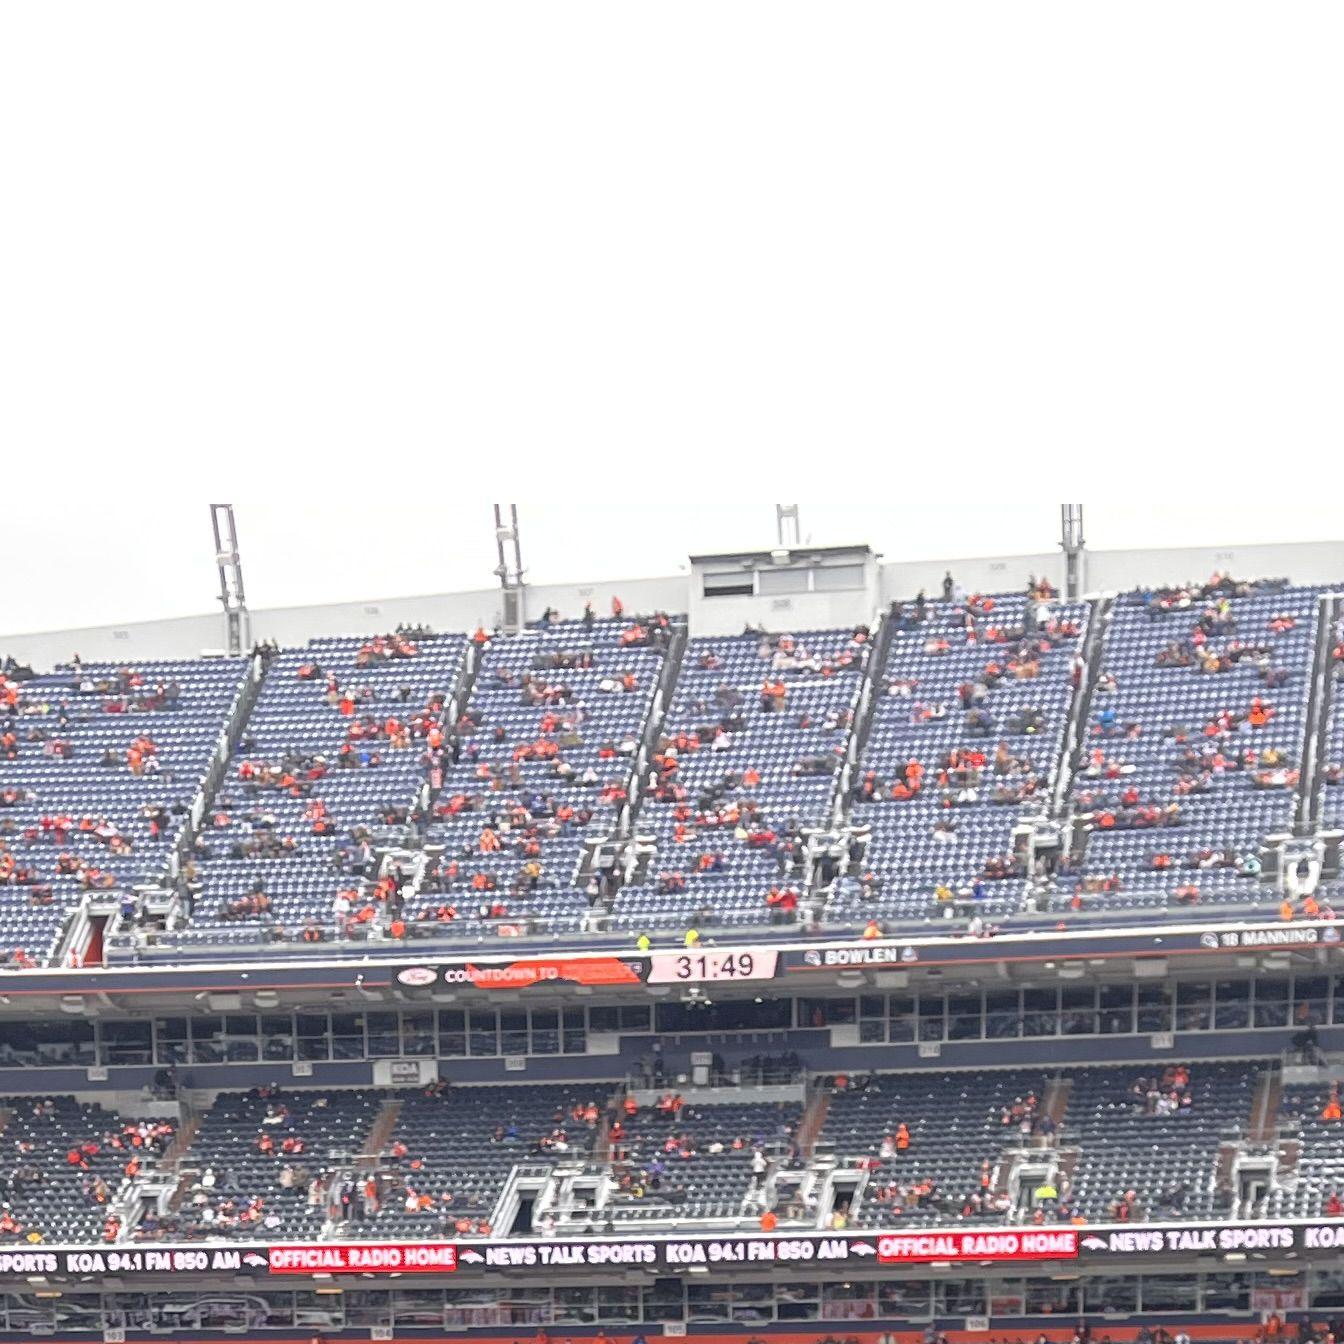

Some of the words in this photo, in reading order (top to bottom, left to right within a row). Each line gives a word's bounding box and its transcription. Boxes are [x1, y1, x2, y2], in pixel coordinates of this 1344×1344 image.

[1241, 928, 1318, 945] MANNING
[676, 953, 754, 979] 31:49
[824, 947, 897, 966] BOWLEN
[444, 967, 537, 983] COUNTDOWN
[539, 966, 558, 979] TO
[878, 1238, 958, 1255] OFFICIAL
[962, 1236, 1019, 1253] RADIO
[1022, 1234, 1076, 1252] HOME
[1110, 1232, 1164, 1251] NEWS
[1167, 1231, 1216, 1249] TALK
[1219, 1229, 1294, 1248] SPORTS
[270, 1250, 345, 1266] OFFICIAL
[348, 1249, 400, 1266] RADIO
[404, 1248, 455, 1265] HOME
[486, 1247, 537, 1265] NEWS
[539, 1247, 586, 1264] TALK
[588, 1245, 656, 1263] SPORTS
[665, 1244, 706, 1262] KOA
[708, 1243, 746, 1261] 94.1
[748, 1242, 774, 1260] FM
[777, 1241, 814, 1259] 850
[817, 1241, 848, 1258] AM
[66, 1254, 105, 1272] KOA
[106, 1253, 142, 1270] 94.1
[145, 1253, 170, 1270] FM
[173, 1252, 209, 1269] 850
[212, 1252, 240, 1269] AM
